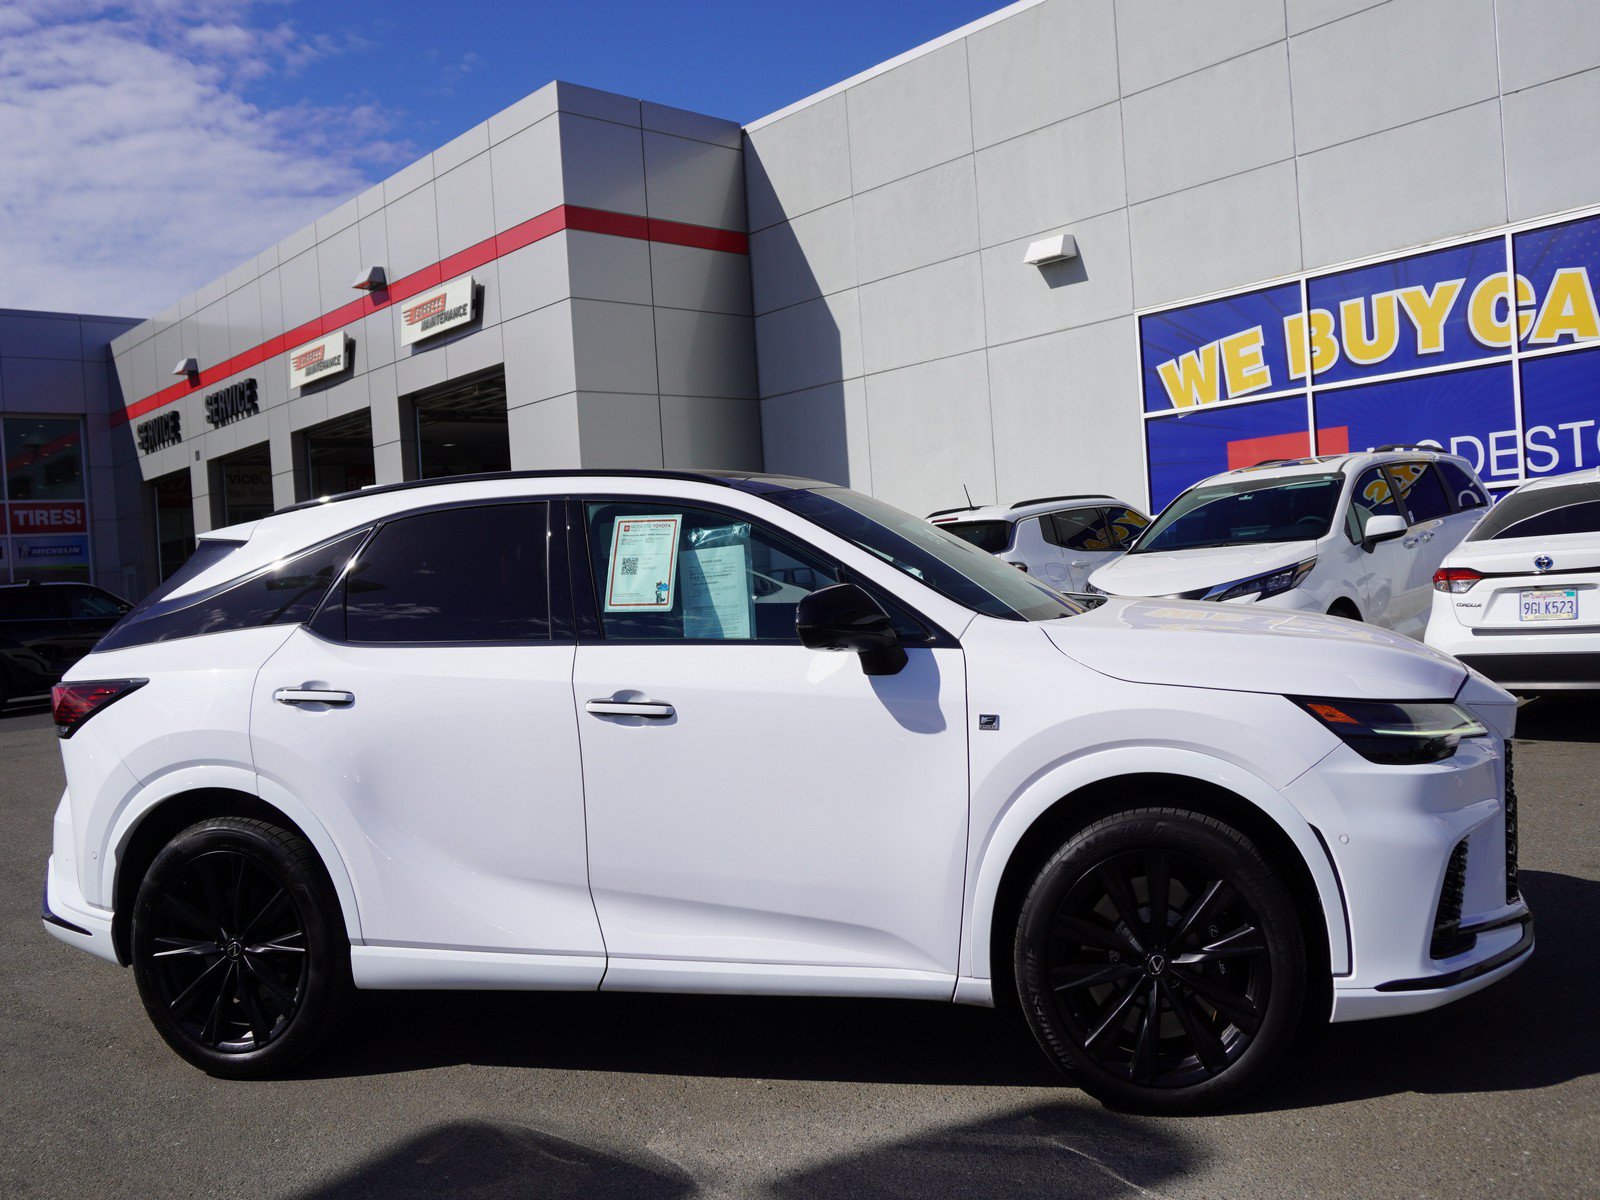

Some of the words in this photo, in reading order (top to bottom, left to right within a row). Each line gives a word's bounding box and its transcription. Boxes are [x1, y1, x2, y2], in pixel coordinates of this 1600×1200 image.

[421, 303, 468, 332] MAINTENANCE
[1156, 325, 1272, 418] WE
[1283, 278, 1466, 380] BUY
[204, 378, 254, 424] SERVICE
[137, 411, 178, 450] SERVICE
[1367, 420, 1600, 477] DEST
[13, 509, 82, 526] TIRES!
[31, 546, 80, 555] MICHELIN
[1524, 601, 1574, 615] 9GLK523
